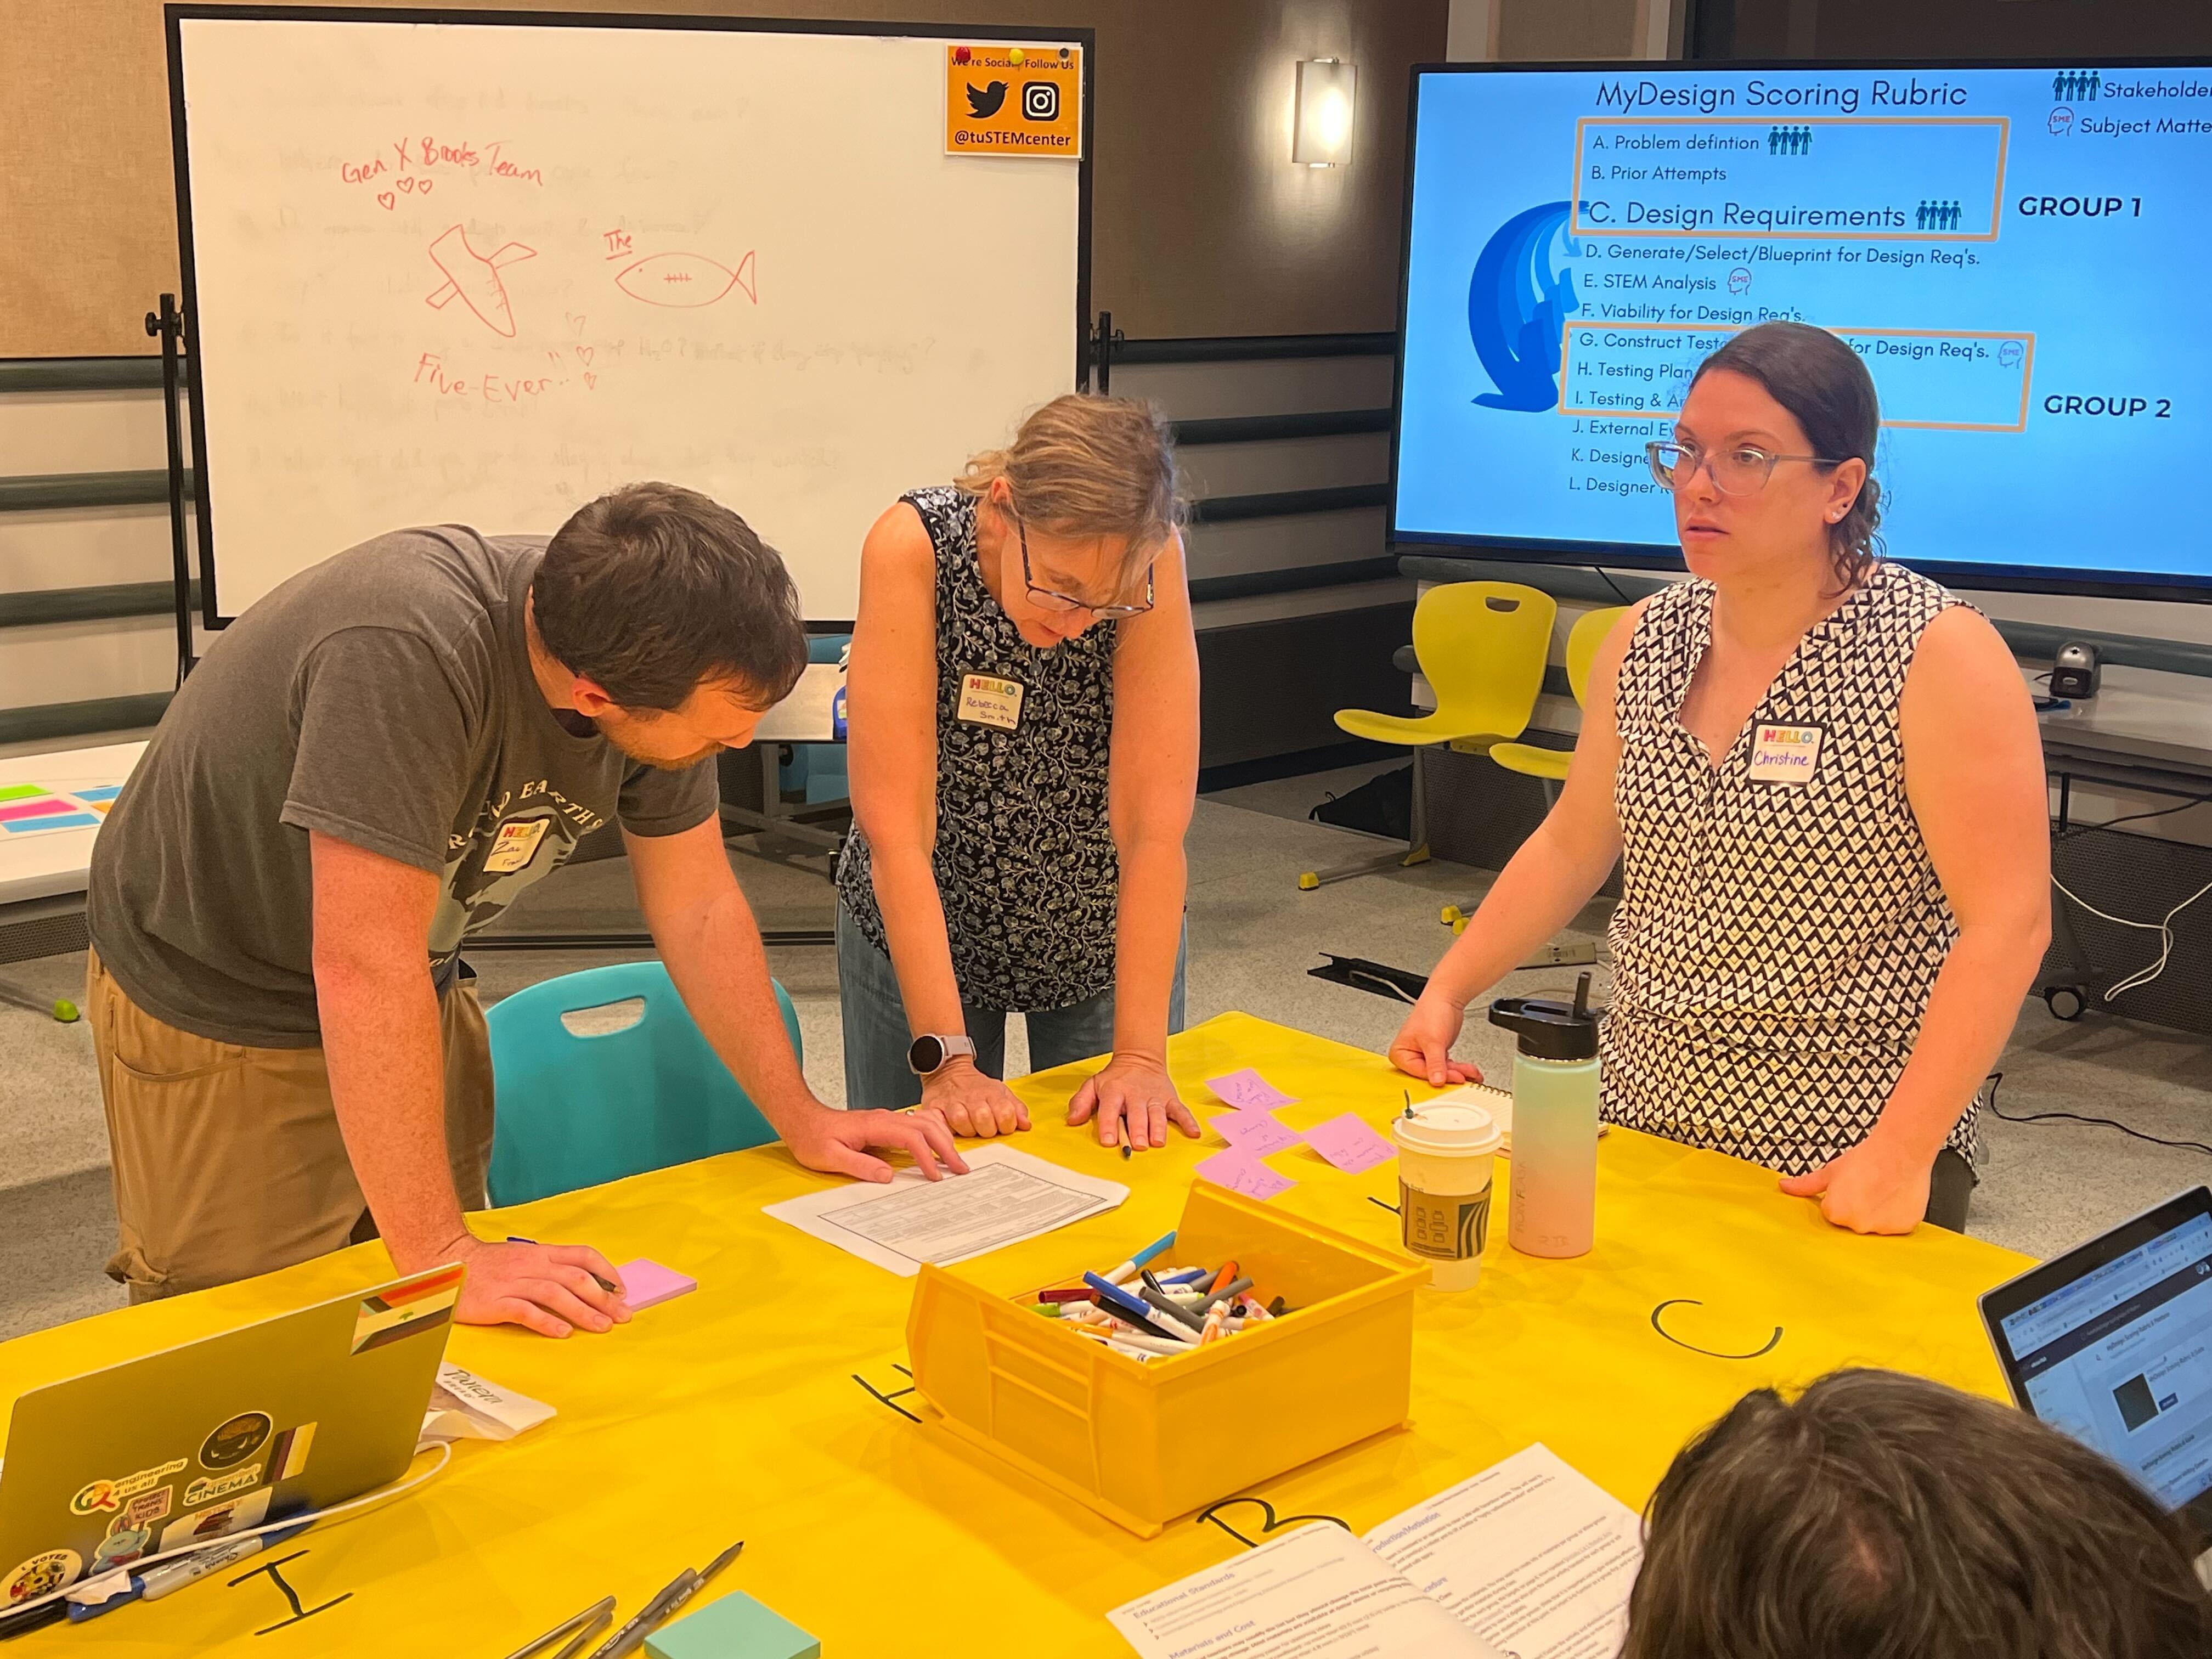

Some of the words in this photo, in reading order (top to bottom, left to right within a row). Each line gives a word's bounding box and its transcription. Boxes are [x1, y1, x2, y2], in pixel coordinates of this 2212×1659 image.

[1025, 59, 1058, 69] Follow
[1062, 60, 1074, 70] Us
[1596, 81, 1735, 114] MyDesign
[1747, 80, 1859, 113] Scoring
[1871, 78, 1967, 105] Rubric
[2081, 116, 2151, 137] Subject
[955, 131, 1070, 145] @tuSTEMcenter
[1593, 136, 1609, 149] A.
[1615, 134, 1680, 149] Problem
[1686, 135, 1759, 150] defintion
[342, 159, 388, 183] Gen
[485, 139, 543, 186] Team
[1592, 166, 1605, 179] B.
[1611, 165, 1647, 180] Prior
[1652, 166, 1726, 184] Attempts
[1589, 201, 1616, 223] C.
[1627, 202, 1713, 230] Design
[1724, 202, 1905, 232] Requirements
[2019, 196, 2123, 216] GROUP
[2131, 198, 2141, 217] 1
[604, 228, 633, 252] The
[1586, 245, 1601, 258] D.
[1608, 244, 1831, 265] Generate/Select/Blueprint
[1838, 246, 1862, 262] for
[1866, 248, 1924, 268] Design
[1931, 248, 1980, 269] Req's.
[1584, 274, 1598, 289] E.
[1604, 274, 1647, 289] STEM
[1652, 274, 1716, 294] Analysis
[1582, 303, 1595, 318] F.
[1601, 303, 1664, 323] Viability
[1670, 304, 1692, 319] for
[1698, 306, 1752, 325] Design
[1580, 332, 1598, 347] G.
[1604, 333, 1681, 349] Construct
[1877, 340, 1933, 360] Design
[1940, 341, 1989, 362] Req's.
[1578, 362, 1592, 376] H.
[1599, 362, 1653, 381] Testing
[1576, 391, 1583, 404] I.
[1590, 391, 1644, 410] Testing
[1650, 393, 1661, 407] &
[2044, 394, 2147, 417] GROUP
[2155, 398, 2171, 418] 2
[1572, 420, 1583, 433] J.
[1590, 420, 1653, 436] External
[1571, 448, 1583, 461] K.
[1570, 476, 1580, 490] L.
[1587, 477, 1656, 496] Designer
[1754, 749, 1809, 766] Christine
[1651, 1299, 1784, 1359] C
[185, 1474, 255, 1503] CINEMA
[31, 1554, 68, 1564] VOTED
[1133, 1592, 1188, 1619] Educational
[1188, 1572, 1235, 1595] Standards
[1233, 1619, 1256, 1634] Cost
